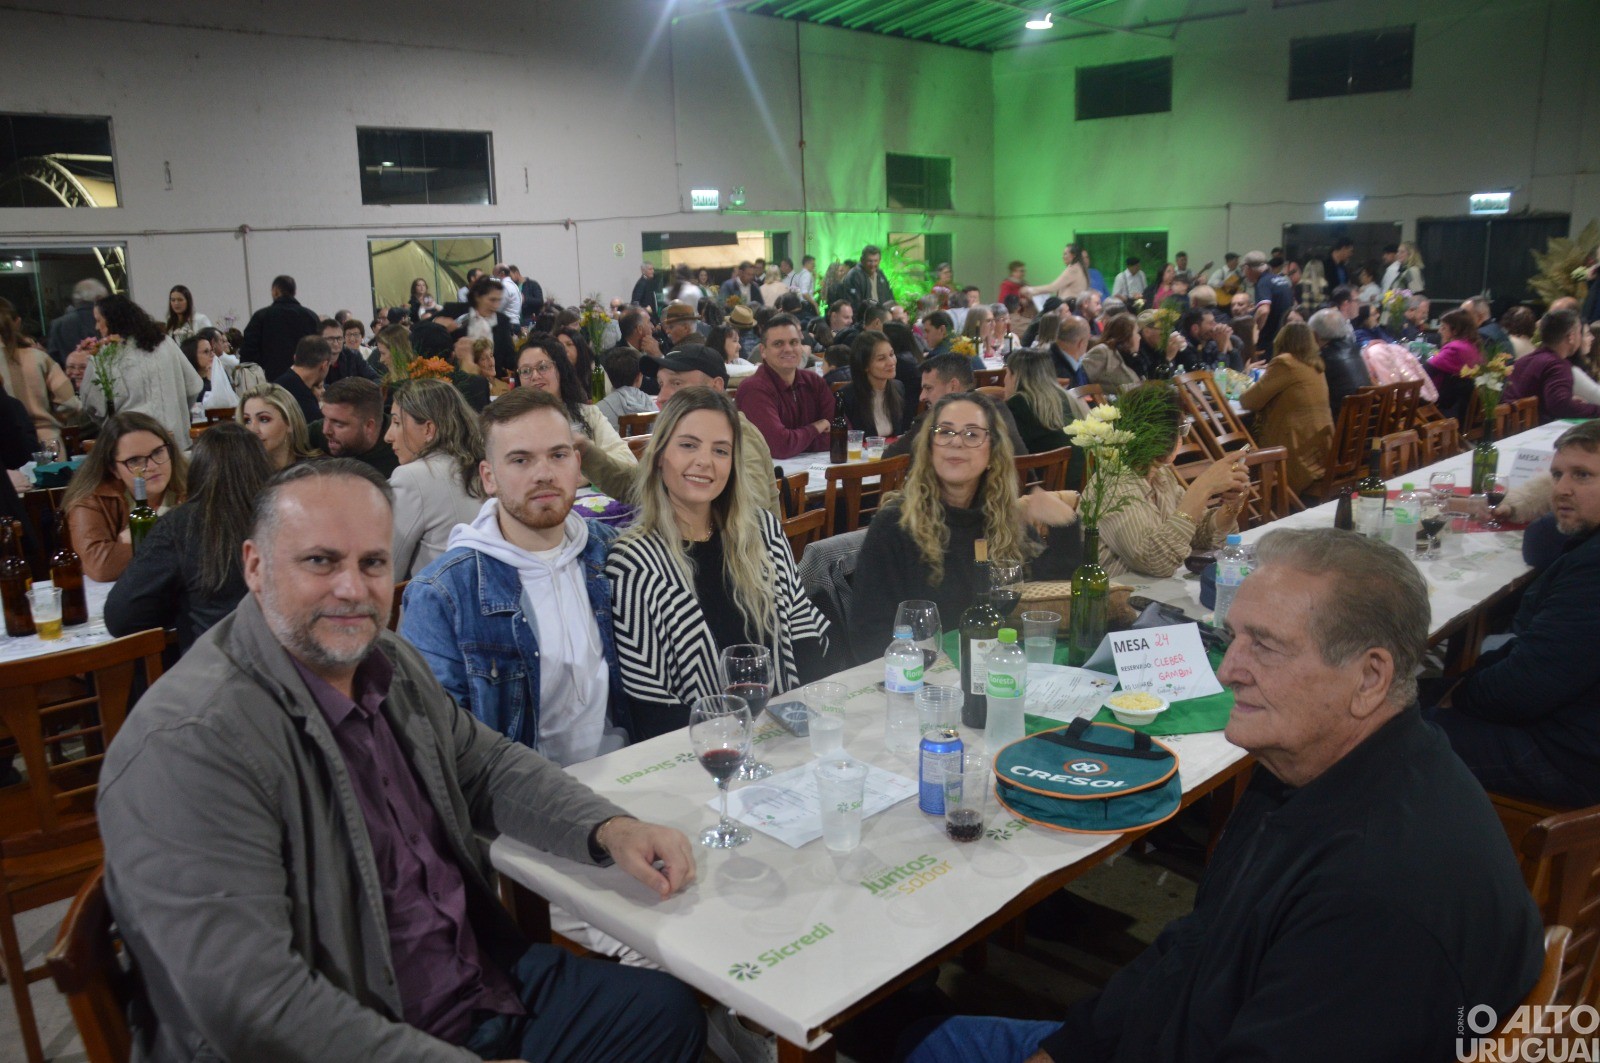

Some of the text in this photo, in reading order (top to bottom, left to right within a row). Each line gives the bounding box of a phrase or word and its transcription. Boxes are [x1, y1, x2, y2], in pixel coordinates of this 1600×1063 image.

[1113, 632, 1170, 653] MESA 24
[1153, 653, 1186, 667] CLEBER
[1158, 667, 1193, 681] GAMBIN
[615, 759, 677, 786] Sicredi
[1010, 765, 1128, 789] CRESOL
[860, 853, 938, 895] Juntos
[897, 859, 953, 895] sabor
[757, 922, 835, 969] Sicredi
